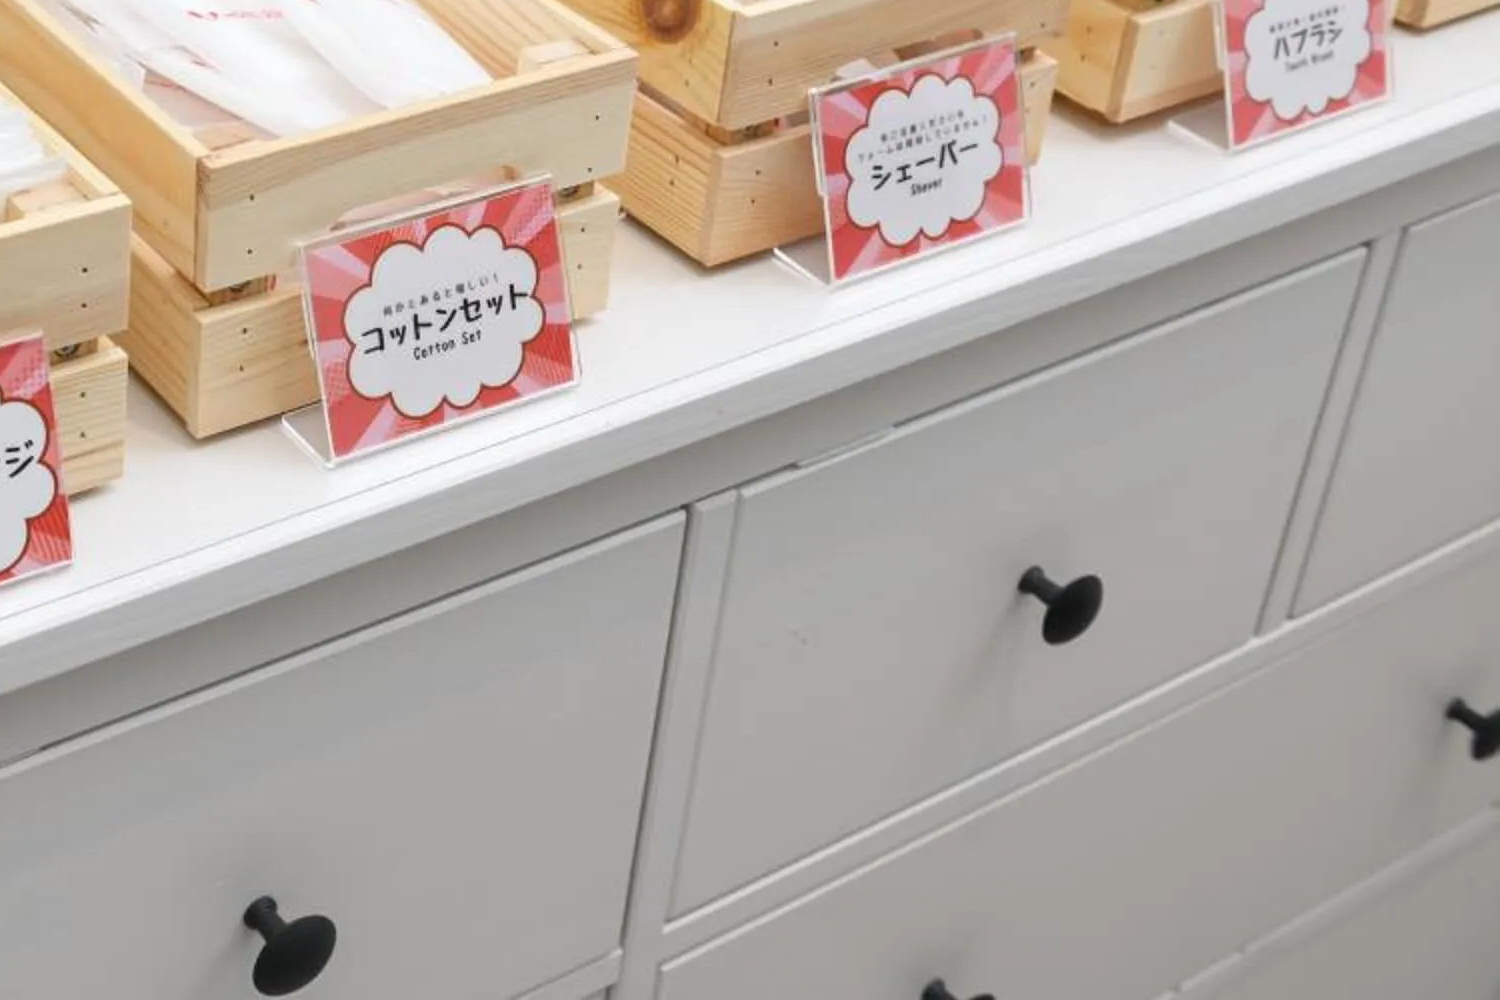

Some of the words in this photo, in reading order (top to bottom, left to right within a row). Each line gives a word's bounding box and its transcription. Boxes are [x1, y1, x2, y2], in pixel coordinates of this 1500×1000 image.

[871, 139, 979, 191] シェーバー
[361, 283, 529, 355] コットンセット
[413, 339, 456, 361] Cotton
[461, 329, 482, 345] Set
